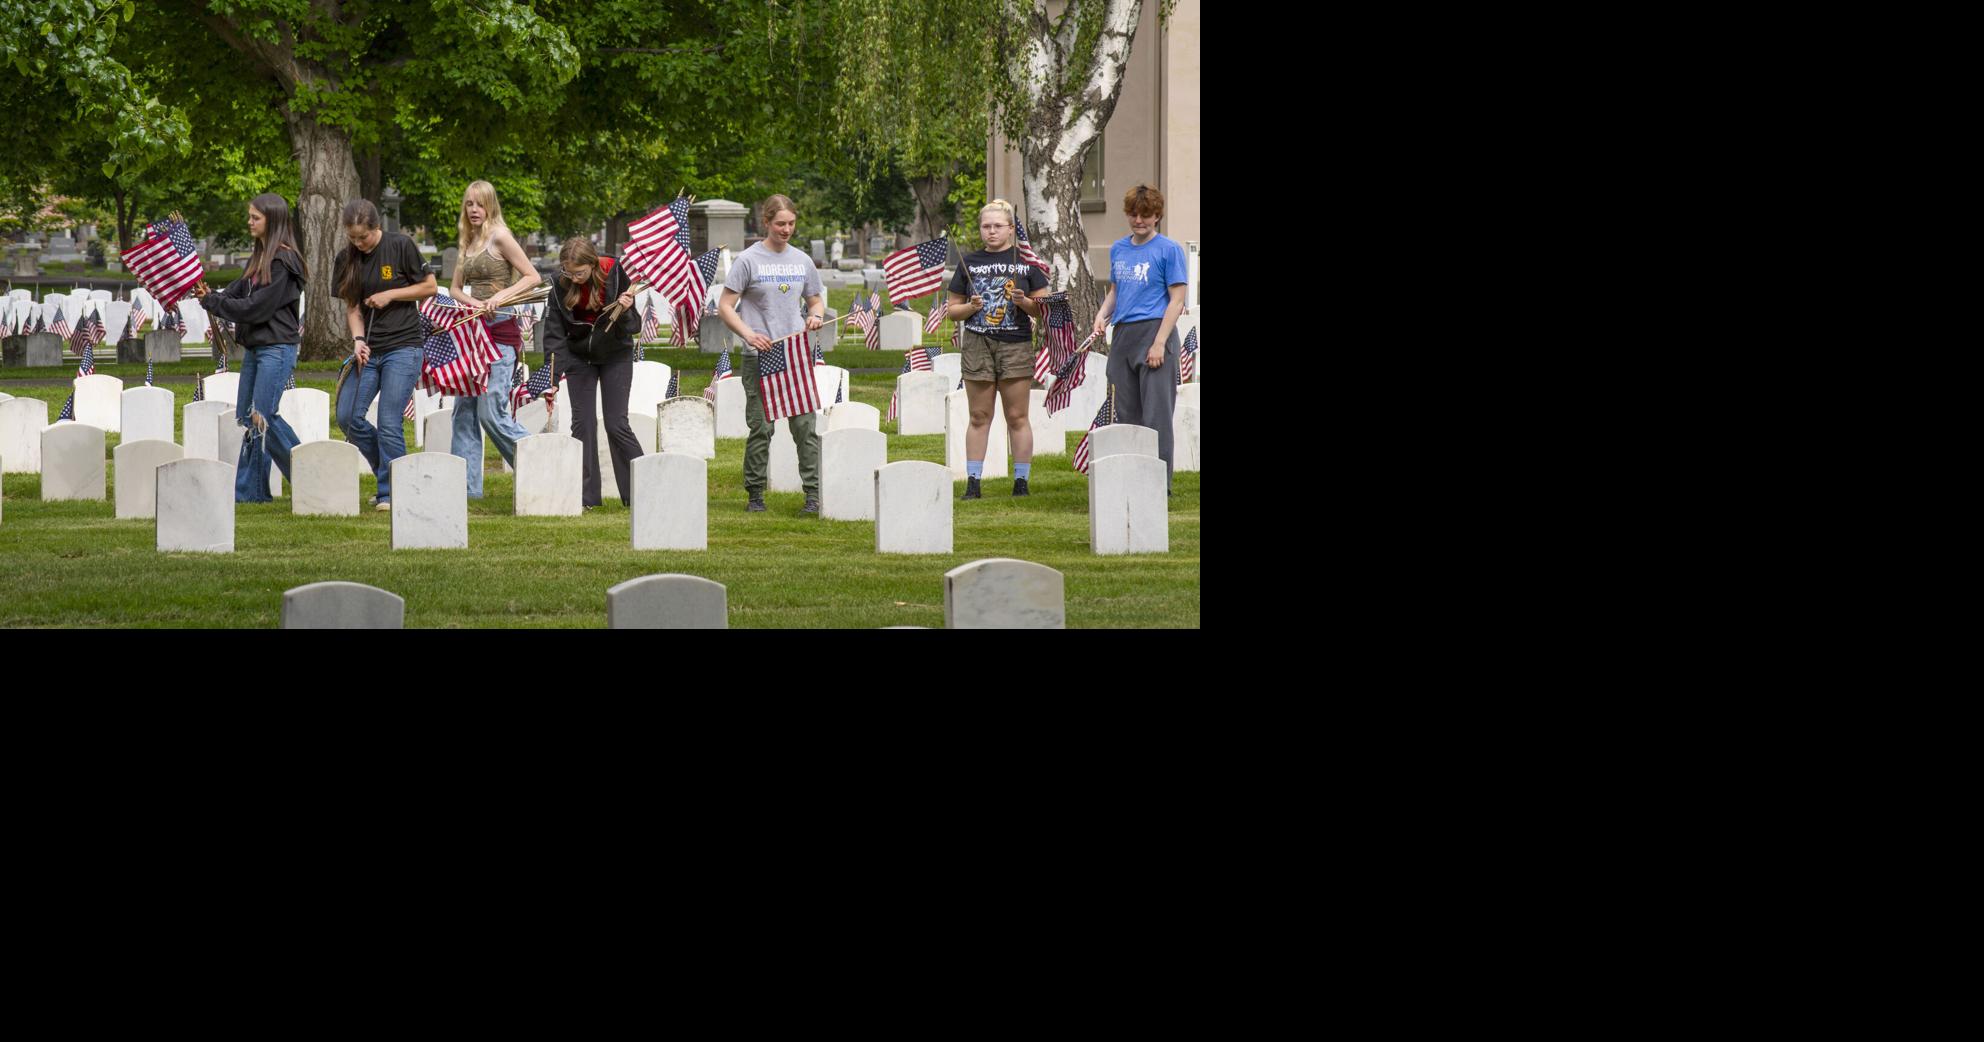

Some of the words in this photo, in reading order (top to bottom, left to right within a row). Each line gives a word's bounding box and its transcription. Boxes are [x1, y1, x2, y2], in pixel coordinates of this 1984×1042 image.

[758, 263, 806, 275] MOREHEAD
[758, 275, 775, 283] STATE
[776, 275, 806, 283] UNIVERSITY
